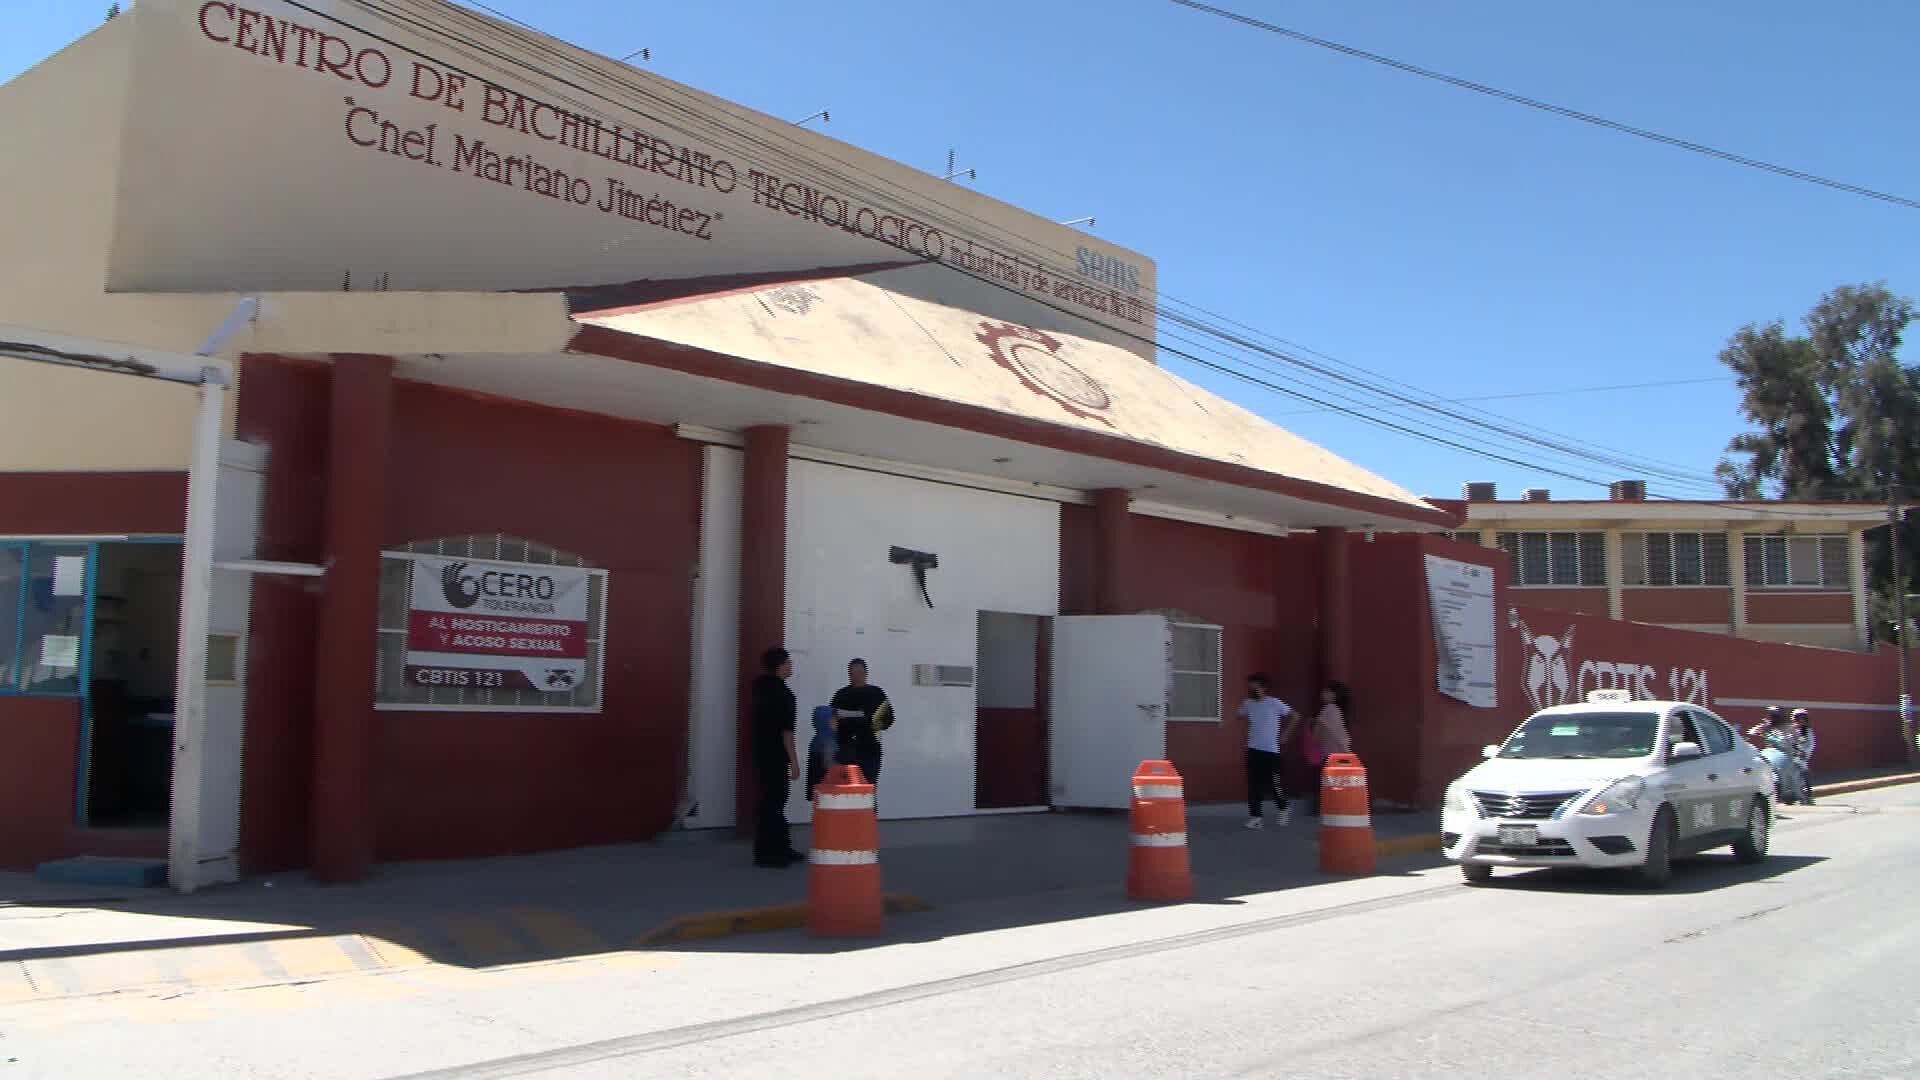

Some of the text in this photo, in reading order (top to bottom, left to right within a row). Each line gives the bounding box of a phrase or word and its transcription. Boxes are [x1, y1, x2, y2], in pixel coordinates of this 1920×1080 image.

[197, 1, 393, 88] CENTRO
[409, 61, 467, 112] DE
[481, 84, 738, 194] BACHILLERATO
[749, 168, 946, 262] TECNOLOGICO
[949, 239, 1020, 286] industrial
[1021, 270, 1031, 291] y
[1031, 263, 1050, 295] de
[1052, 279, 1108, 315] servicios
[452, 133, 592, 206] Mariano
[480, 570, 556, 601] CERO
[481, 597, 557, 615] TOLERANCIA
[428, 616, 572, 638] AL HOSTIGAMIENTO
[439, 632, 564, 653] Y ACOSO SEXUAL
[414, 667, 505, 687] CBTIS 121
[1668, 665, 1708, 708] 121
[1595, 691, 1619, 701] TAXI
